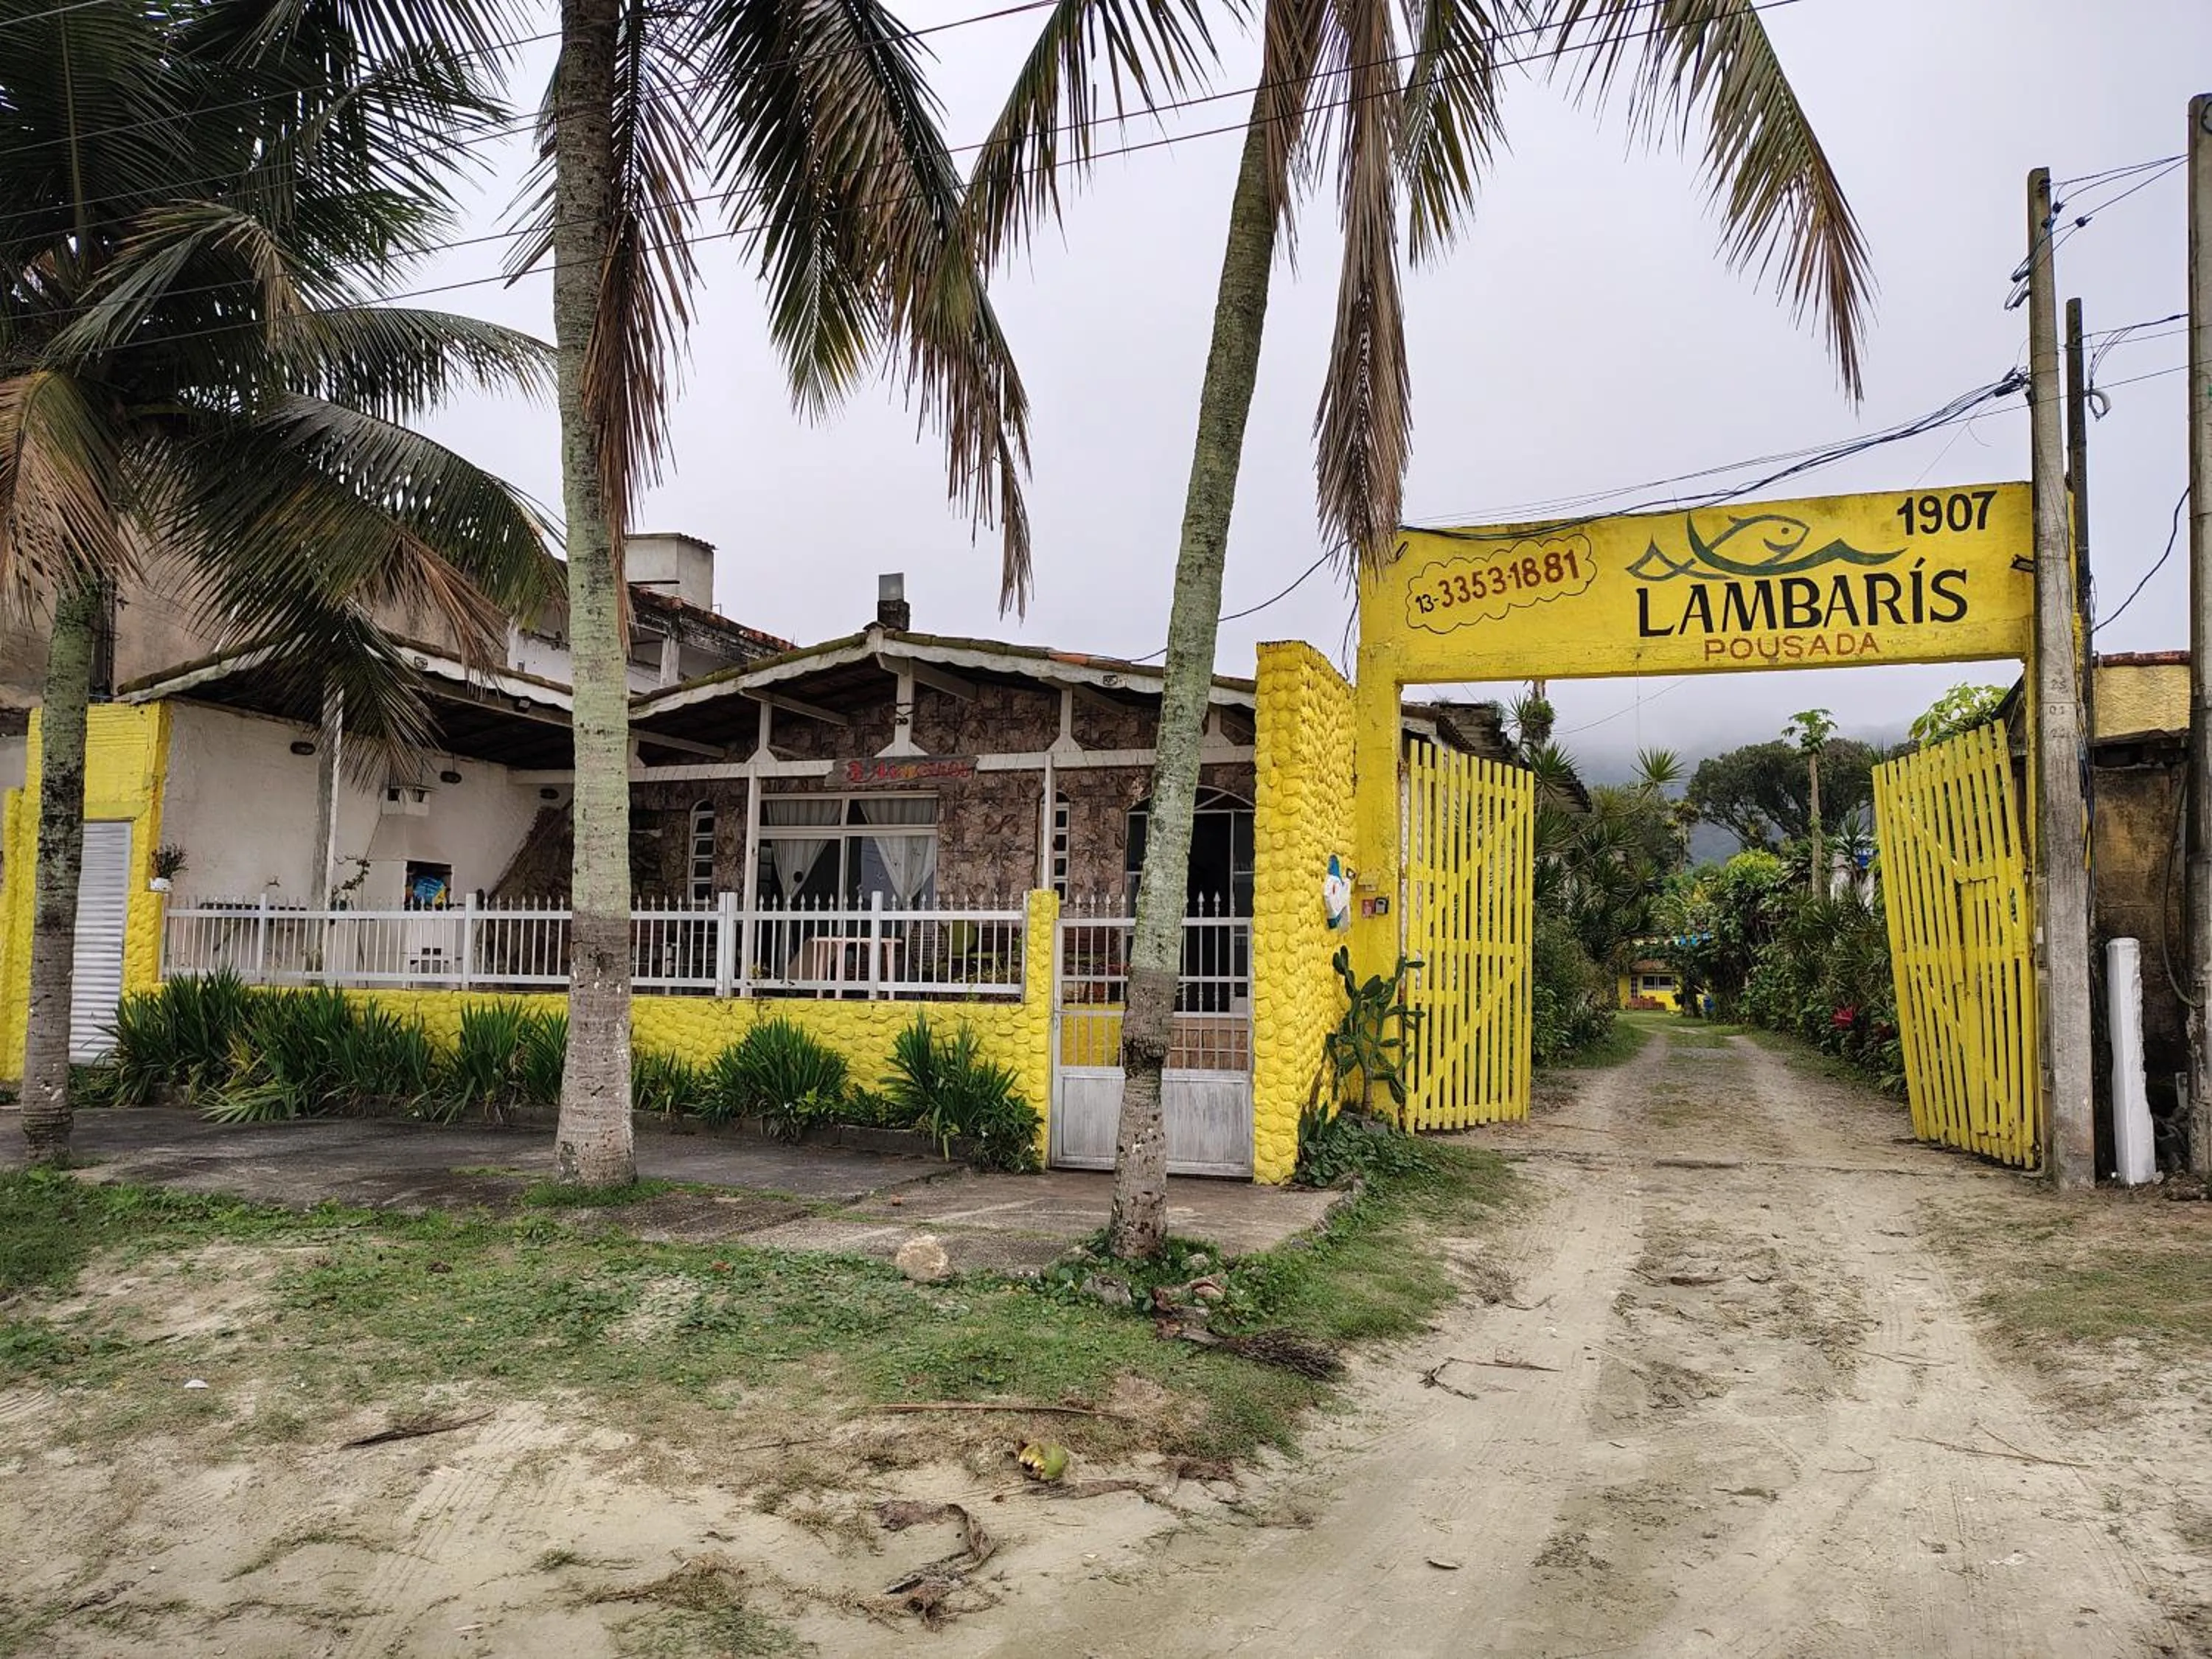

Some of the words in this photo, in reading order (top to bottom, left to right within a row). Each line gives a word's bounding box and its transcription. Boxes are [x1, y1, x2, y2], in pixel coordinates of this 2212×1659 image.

[1896, 490, 1997, 536] 1907
[1636, 557, 1969, 638] LAMBARÍS
[1704, 632, 1879, 661] POUSADA
